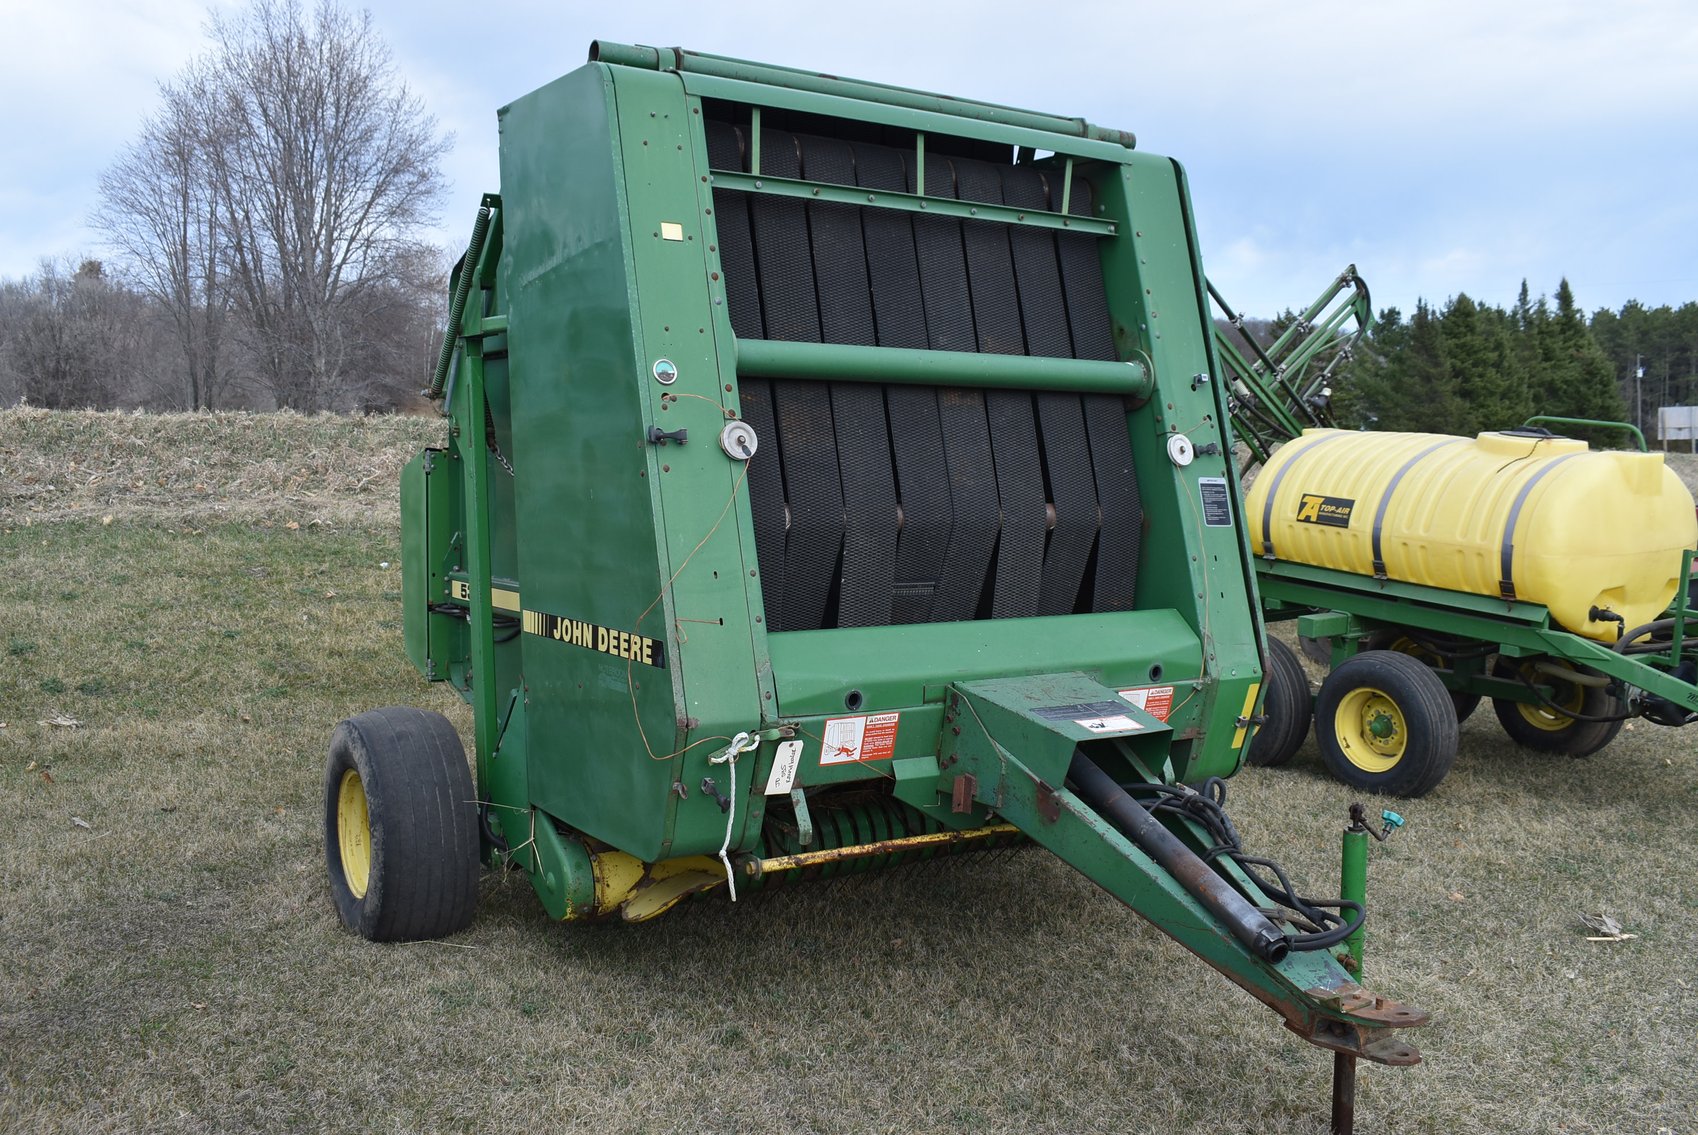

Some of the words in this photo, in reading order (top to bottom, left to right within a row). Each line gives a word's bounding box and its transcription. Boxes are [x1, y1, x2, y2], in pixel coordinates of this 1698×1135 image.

[1320, 505, 1351, 514] TOP-AIR
[461, 583, 470, 599] 5
[553, 616, 593, 649] JOHN
[598, 626, 653, 665] DEERE
[874, 715, 897, 723] DANGER
